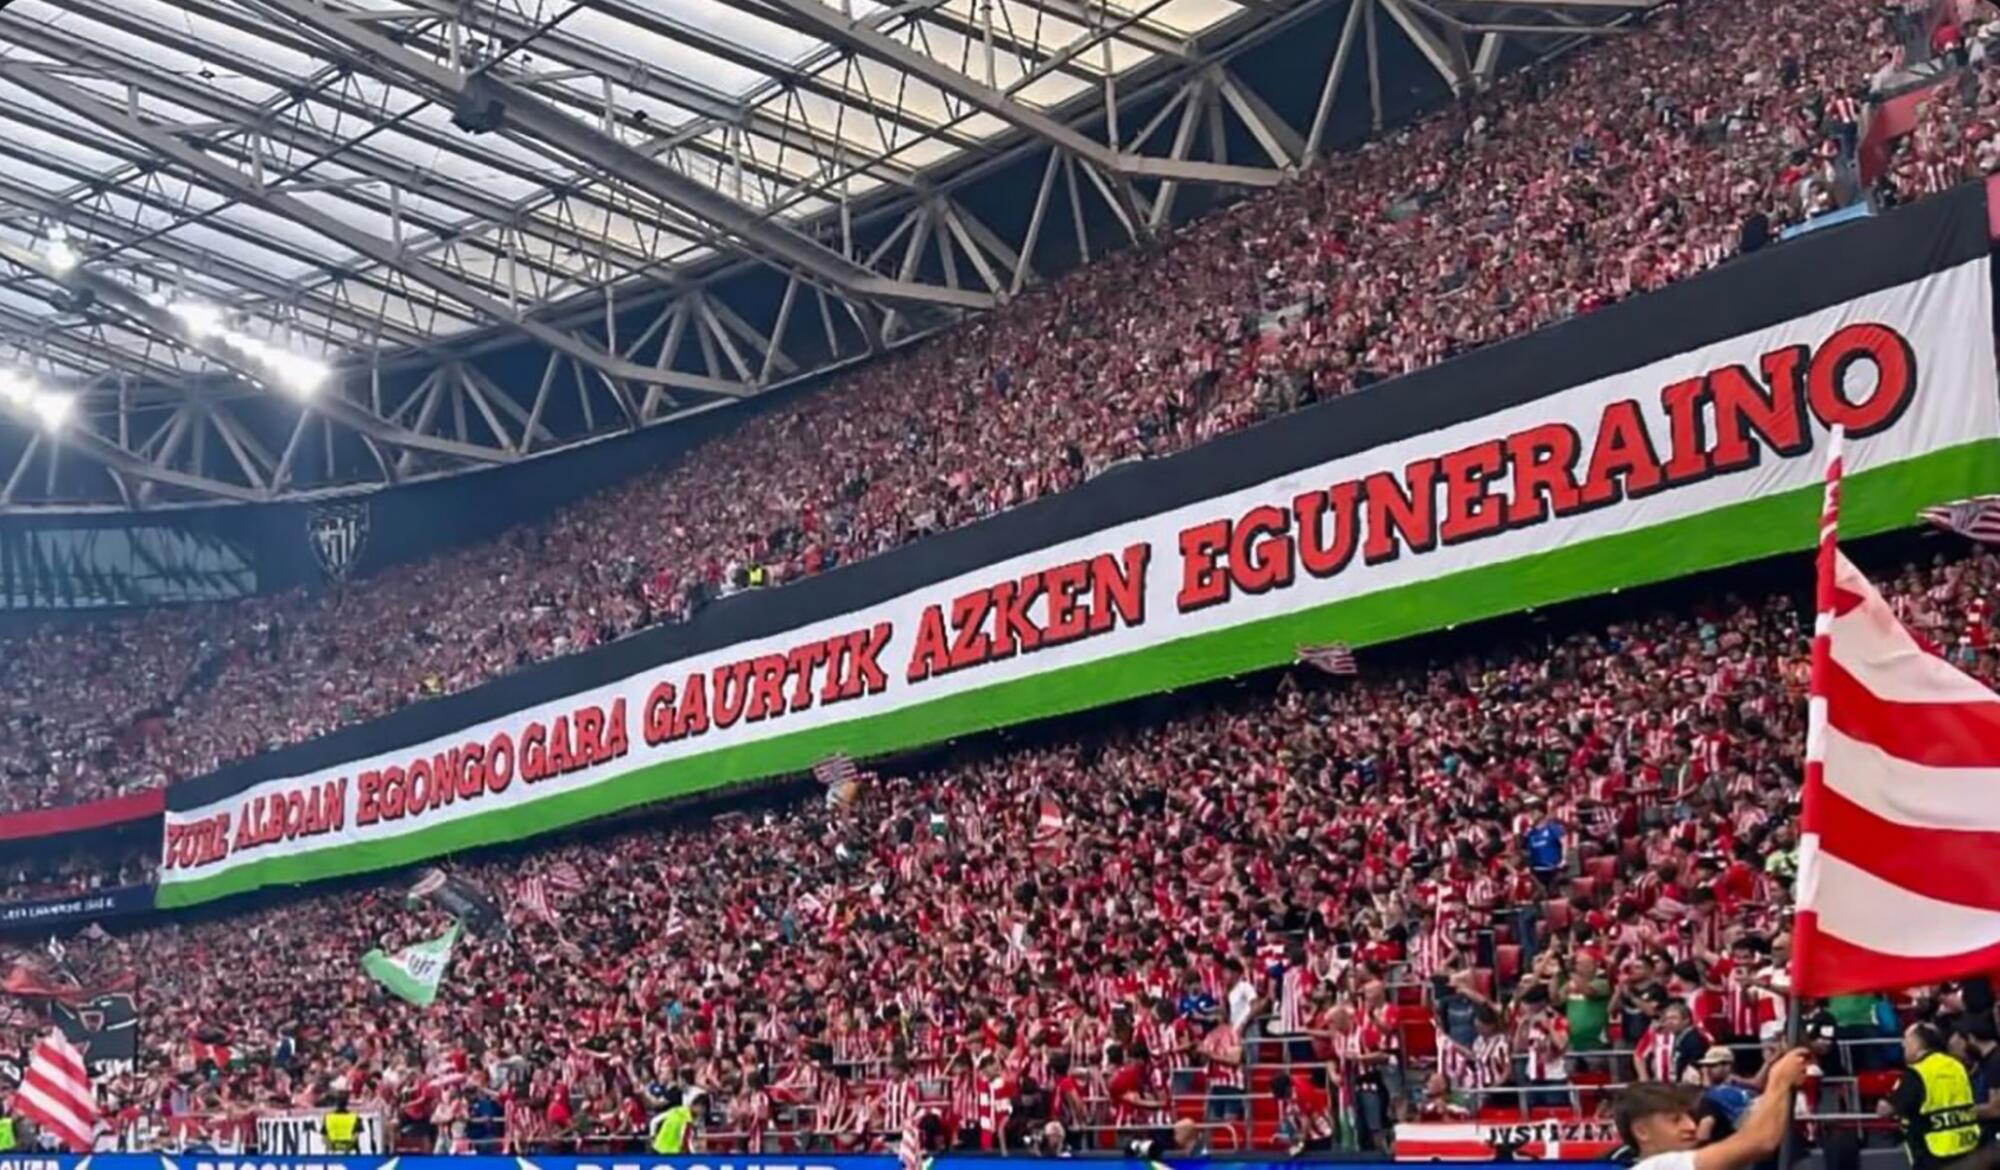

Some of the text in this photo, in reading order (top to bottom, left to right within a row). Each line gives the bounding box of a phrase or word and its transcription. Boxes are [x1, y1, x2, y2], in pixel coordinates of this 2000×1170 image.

[232, 776, 349, 853] ALBOAN
[355, 732, 513, 826] EGONGO
[518, 697, 628, 783] GARA
[643, 621, 892, 747] GAURTIK
[907, 542, 1151, 684] AZKEN
[1177, 322, 1917, 610] EGUNERAINO
